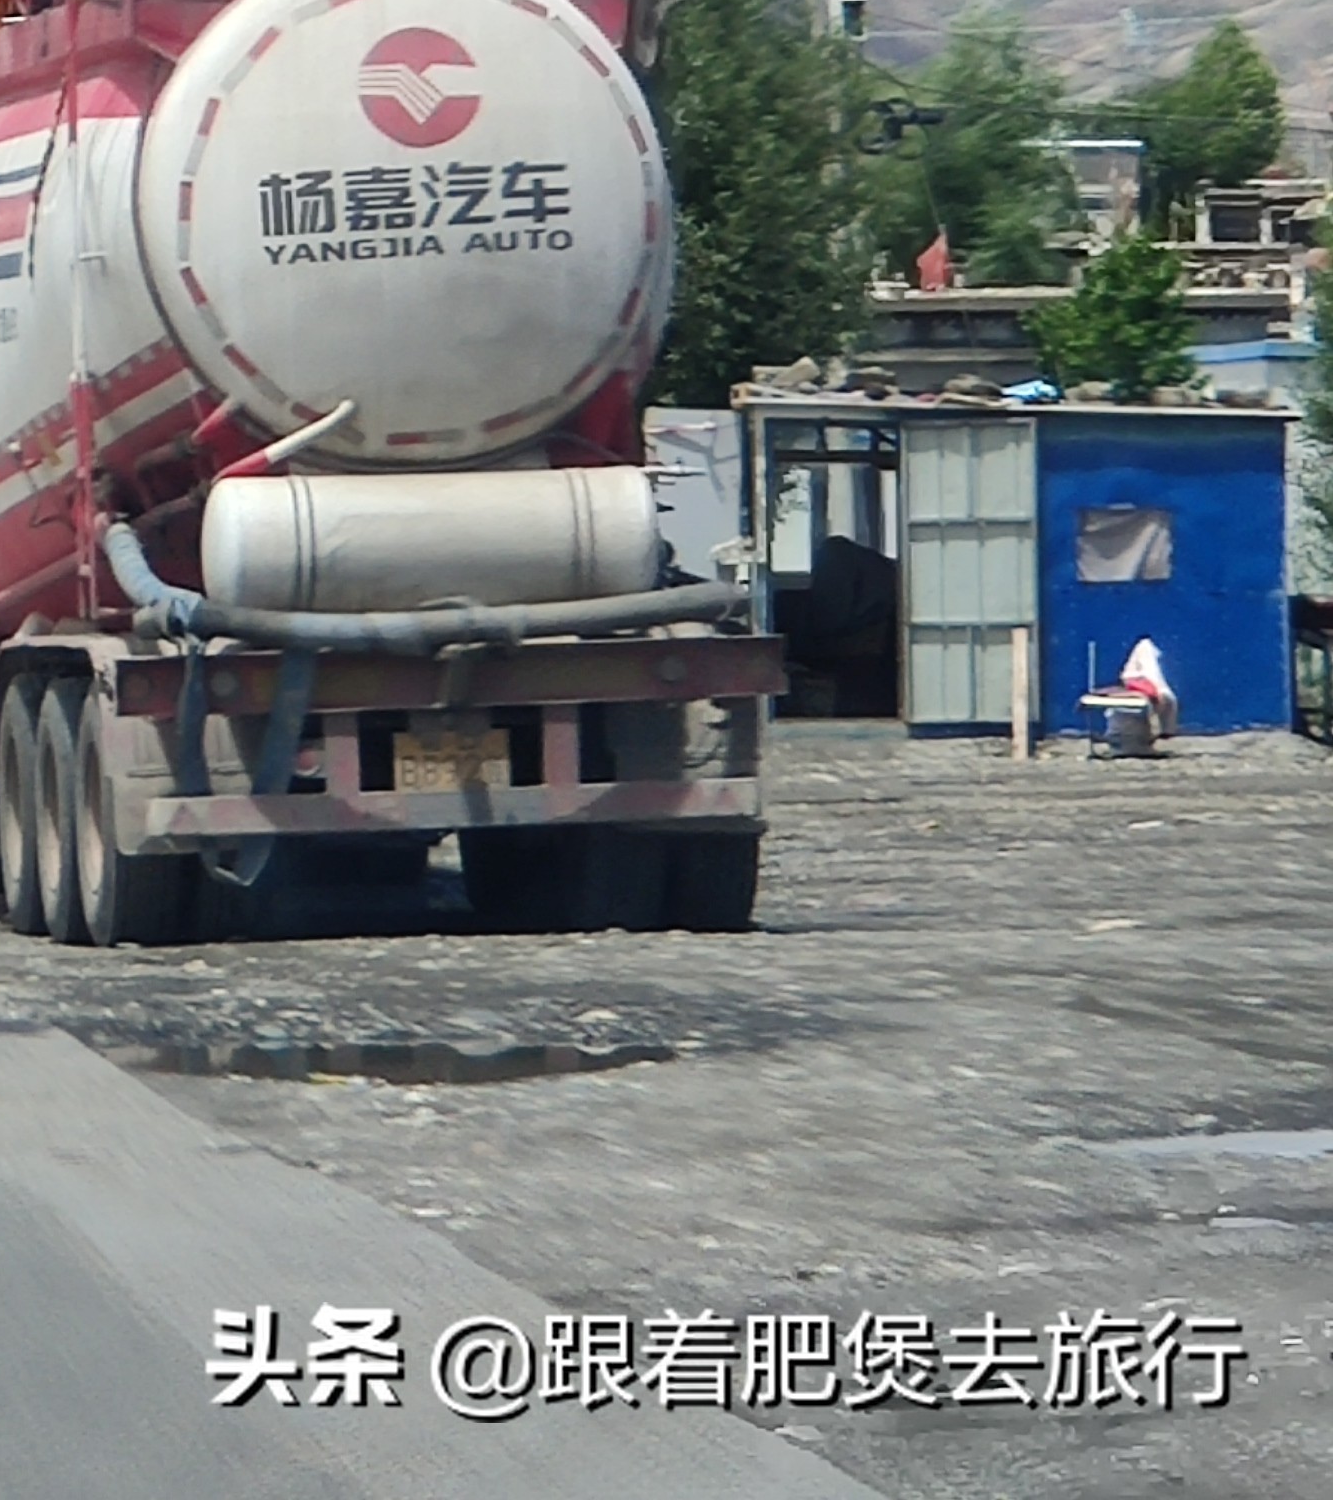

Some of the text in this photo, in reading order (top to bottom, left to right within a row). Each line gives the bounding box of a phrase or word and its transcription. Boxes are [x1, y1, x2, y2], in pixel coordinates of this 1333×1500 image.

[258, 161, 571, 237] 杨嘉汽车
[263, 228, 574, 265] YANGJIA AUTO
